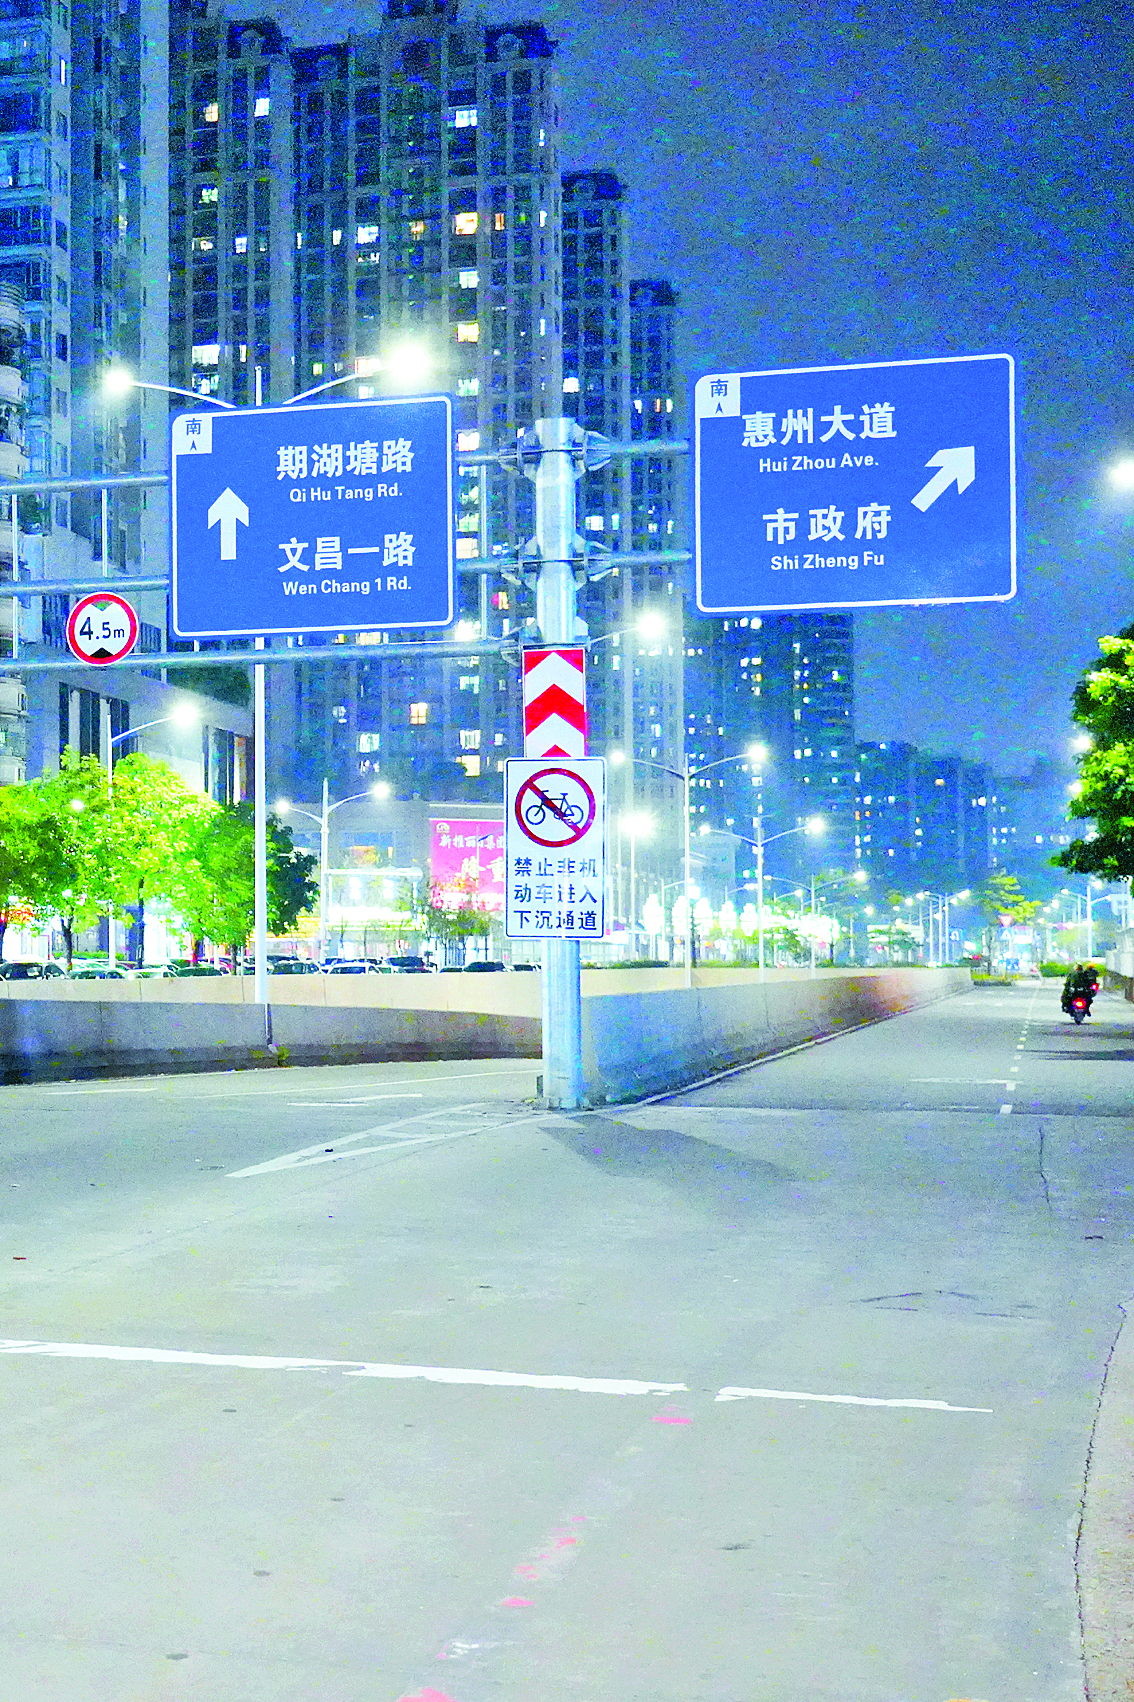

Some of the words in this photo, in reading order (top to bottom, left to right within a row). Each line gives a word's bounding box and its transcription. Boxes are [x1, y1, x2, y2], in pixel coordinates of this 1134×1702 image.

[710, 379, 729, 398] 南
[185, 418, 202, 436] 南
[742, 402, 897, 447] 惠州大道
[276, 438, 415, 480] 期湖塘路
[759, 457, 788, 473] Hui
[792, 455, 836, 471] Zhou
[840, 453, 879, 468] Ave.
[289, 488, 307, 503] Qi
[311, 488, 331, 501] Hu
[335, 486, 374, 502] Tang
[377, 483, 403, 498] Rd.
[762, 502, 892, 545] 市政府
[277, 532, 416, 572] 文昌一路
[771, 555, 799, 570] Shi
[803, 553, 859, 569] Zheng
[863, 551, 885, 566] Fu
[283, 581, 317, 596] Wen
[321, 579, 370, 595] Chang
[374, 578, 382, 592] 1
[386, 576, 412, 591] Rd.
[79, 617, 125, 641] 4.5m
[514, 858, 598, 878] 禁止非机
[514, 884, 598, 903] 动车进入
[514, 910, 598, 930] 下沉通道
